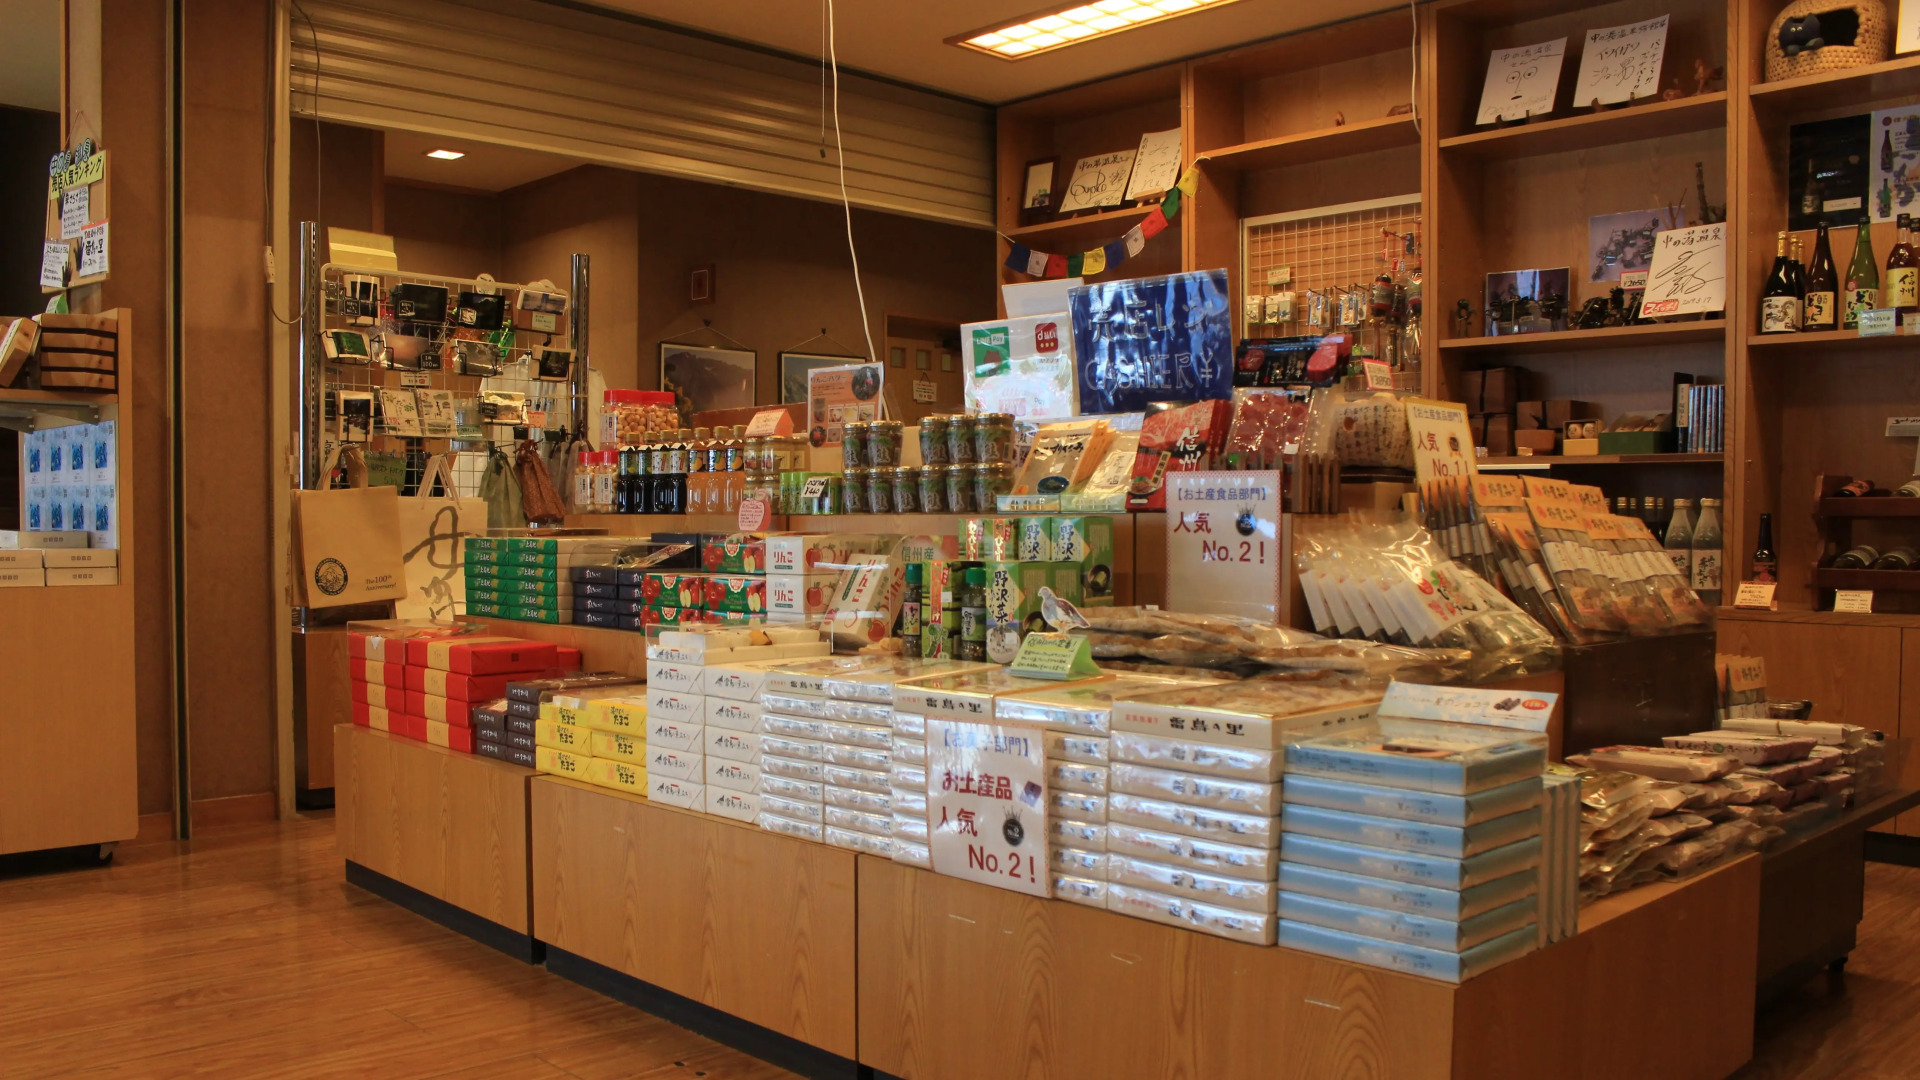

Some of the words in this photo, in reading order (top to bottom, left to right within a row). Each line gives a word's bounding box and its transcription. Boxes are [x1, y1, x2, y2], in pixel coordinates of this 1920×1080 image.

[1663, 227, 1721, 248] 中の湯温泉
[1899, 271, 1915, 297] 信州
[1417, 430, 1439, 452] 人気
[1176, 487, 1268, 501] 【お土産食品部門】
[1173, 511, 1211, 534] 人気
[774, 552, 793, 563] りんご
[902, 546, 934, 562] 信州産
[1202, 540, 1265, 564] No.2!
[774, 590, 793, 601] りんご
[994, 571, 1009, 623] 野沢菜
[925, 697, 983, 713] 雷鳥の里
[561, 713, 575, 726] たまご
[613, 713, 629, 726] たまご
[1169, 716, 1246, 737] 雷鳥の里
[559, 733, 574, 744] たまご
[617, 742, 633, 755] たまご
[560, 760, 575, 772] たまご
[619, 772, 635, 785] たまご
[942, 771, 1013, 800] お土産品
[936, 806, 978, 838] 人気
[968, 844, 1036, 883] No.2!
